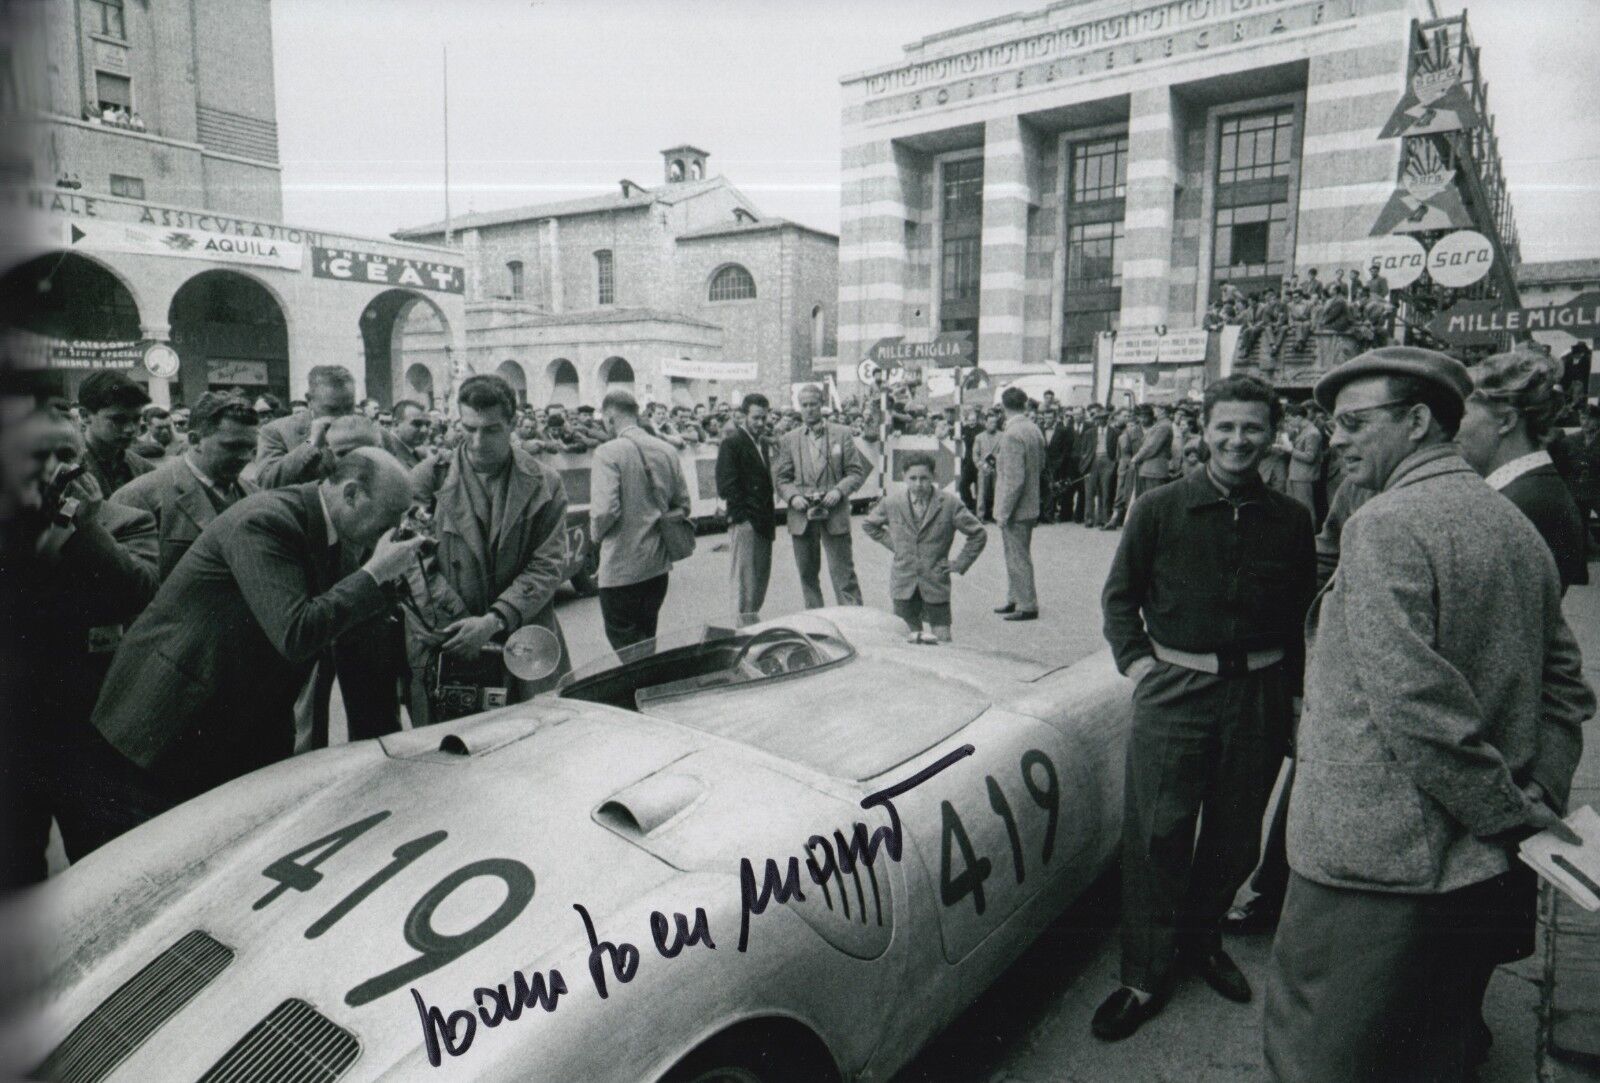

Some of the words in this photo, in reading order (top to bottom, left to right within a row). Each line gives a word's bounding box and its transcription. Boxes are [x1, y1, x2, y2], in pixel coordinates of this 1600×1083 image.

[204, 237, 280, 258] AQUILA
[327, 249, 454, 275] PNEUMATICI
[329, 257, 453, 290] CEAT
[1448, 311, 1520, 333] MILLE
[877, 344, 912, 359] MILLE
[914, 342, 961, 358] MIGLIA
[940, 748, 1060, 917] 419
[251, 809, 537, 1009] 419
